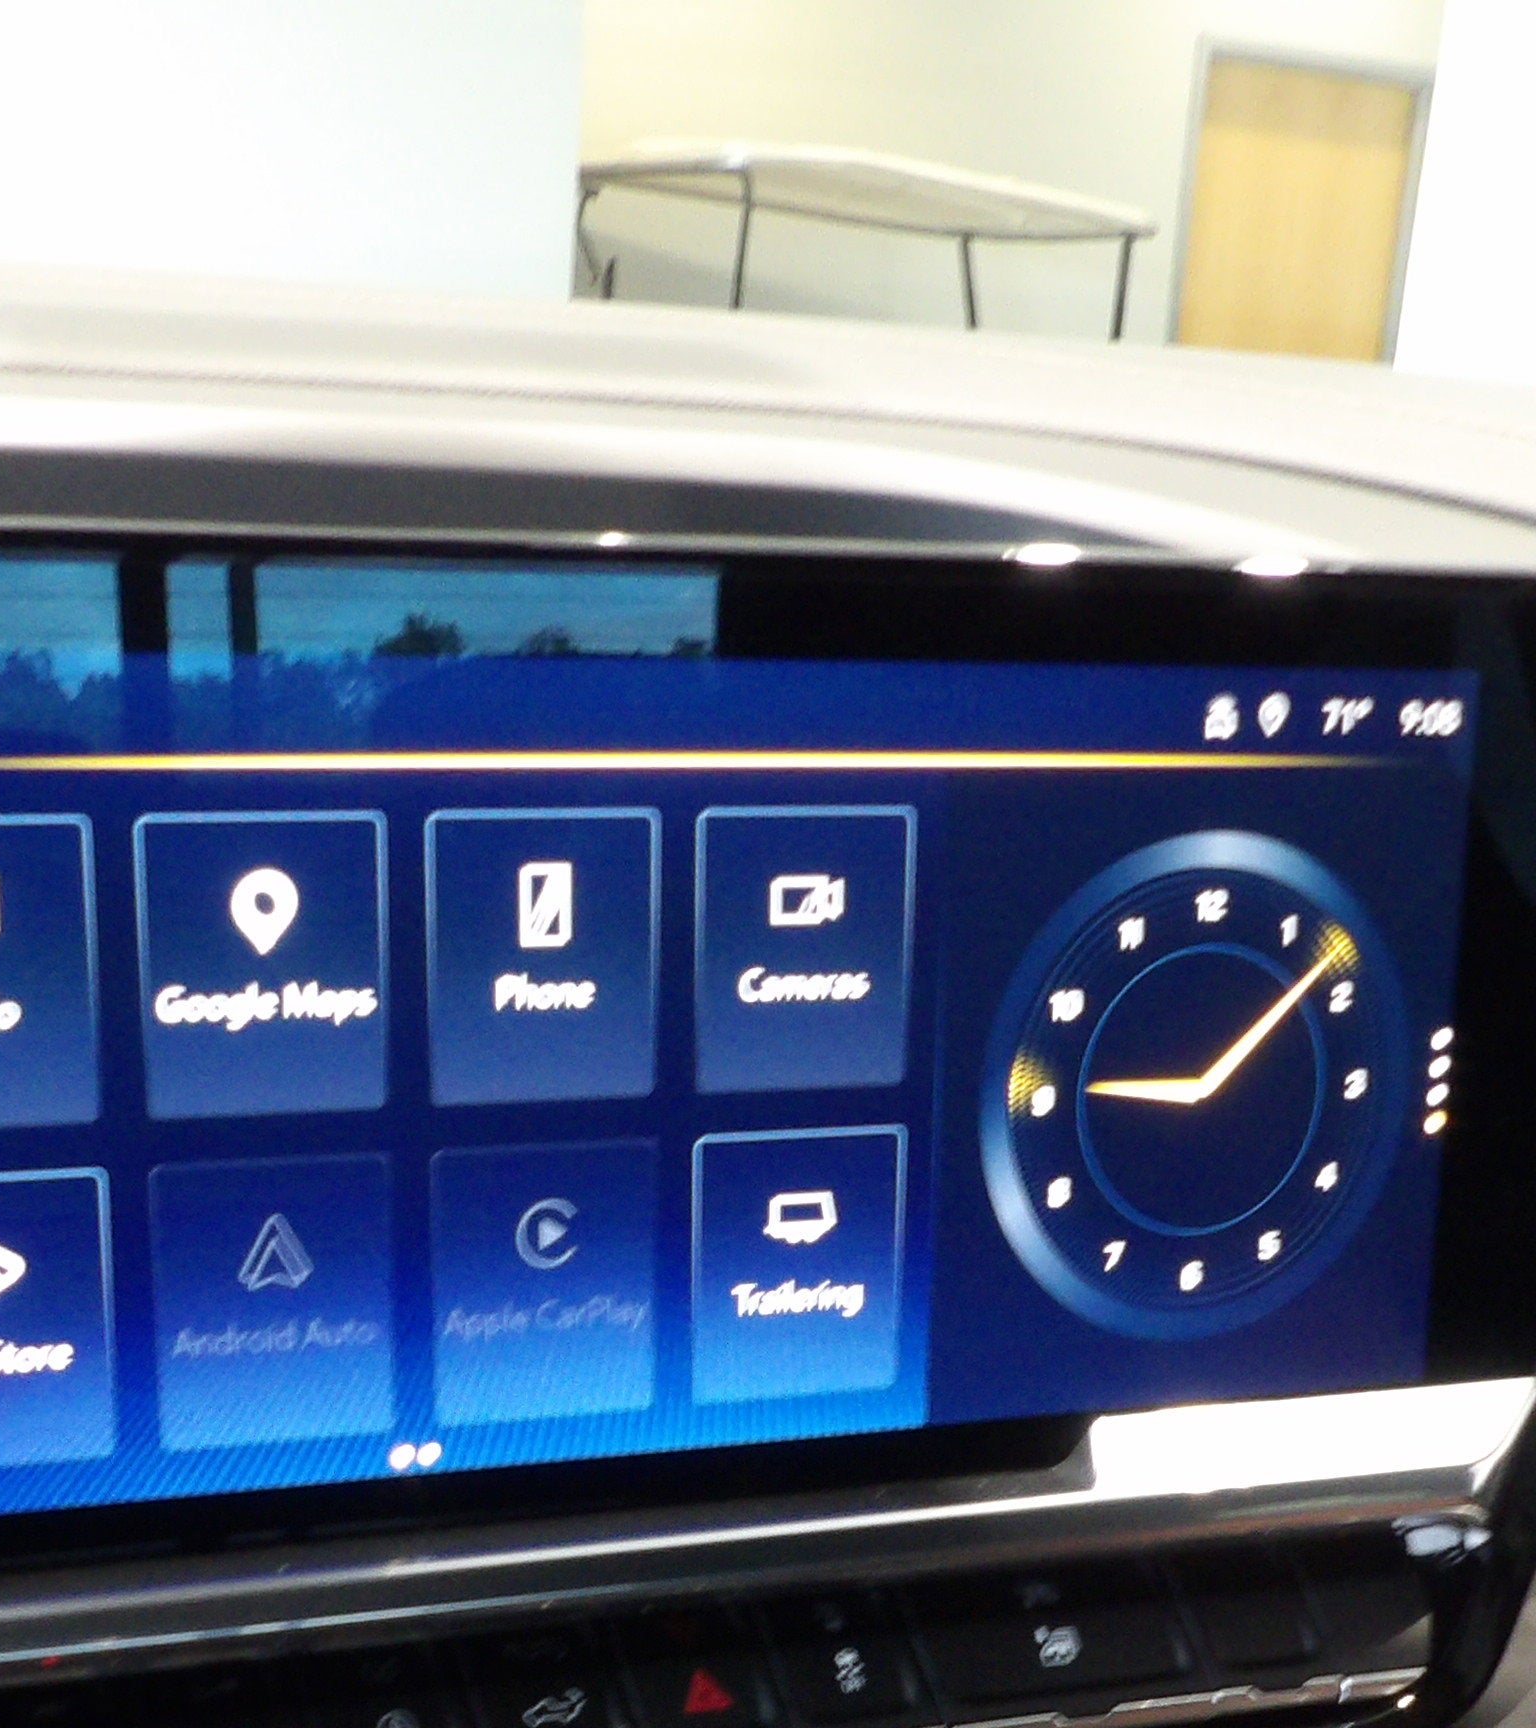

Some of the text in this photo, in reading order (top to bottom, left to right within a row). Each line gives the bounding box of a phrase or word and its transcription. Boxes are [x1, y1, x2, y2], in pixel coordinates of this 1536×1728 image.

[1194, 888, 1230, 924] 12
[1117, 917, 1147, 951] 11
[1280, 914, 1300, 946] 1
[493, 973, 598, 1012] Phone
[738, 967, 871, 1005] Cameras
[1328, 980, 1354, 1014] 2
[155, 981, 378, 1033] Google Maps
[1049, 988, 1086, 1023] 10
[1031, 1083, 1057, 1118] 9
[1343, 1067, 1369, 1101] 3
[1047, 1175, 1073, 1209] 8
[1314, 1160, 1339, 1191] 4
[1102, 1239, 1126, 1272] 7
[1257, 1231, 1283, 1260] 5
[1179, 1259, 1205, 1291] 6
[731, 1279, 865, 1319] Trailering
[444, 1297, 648, 1341] Apple CarPlay
[172, 1316, 379, 1357] Android Auto
